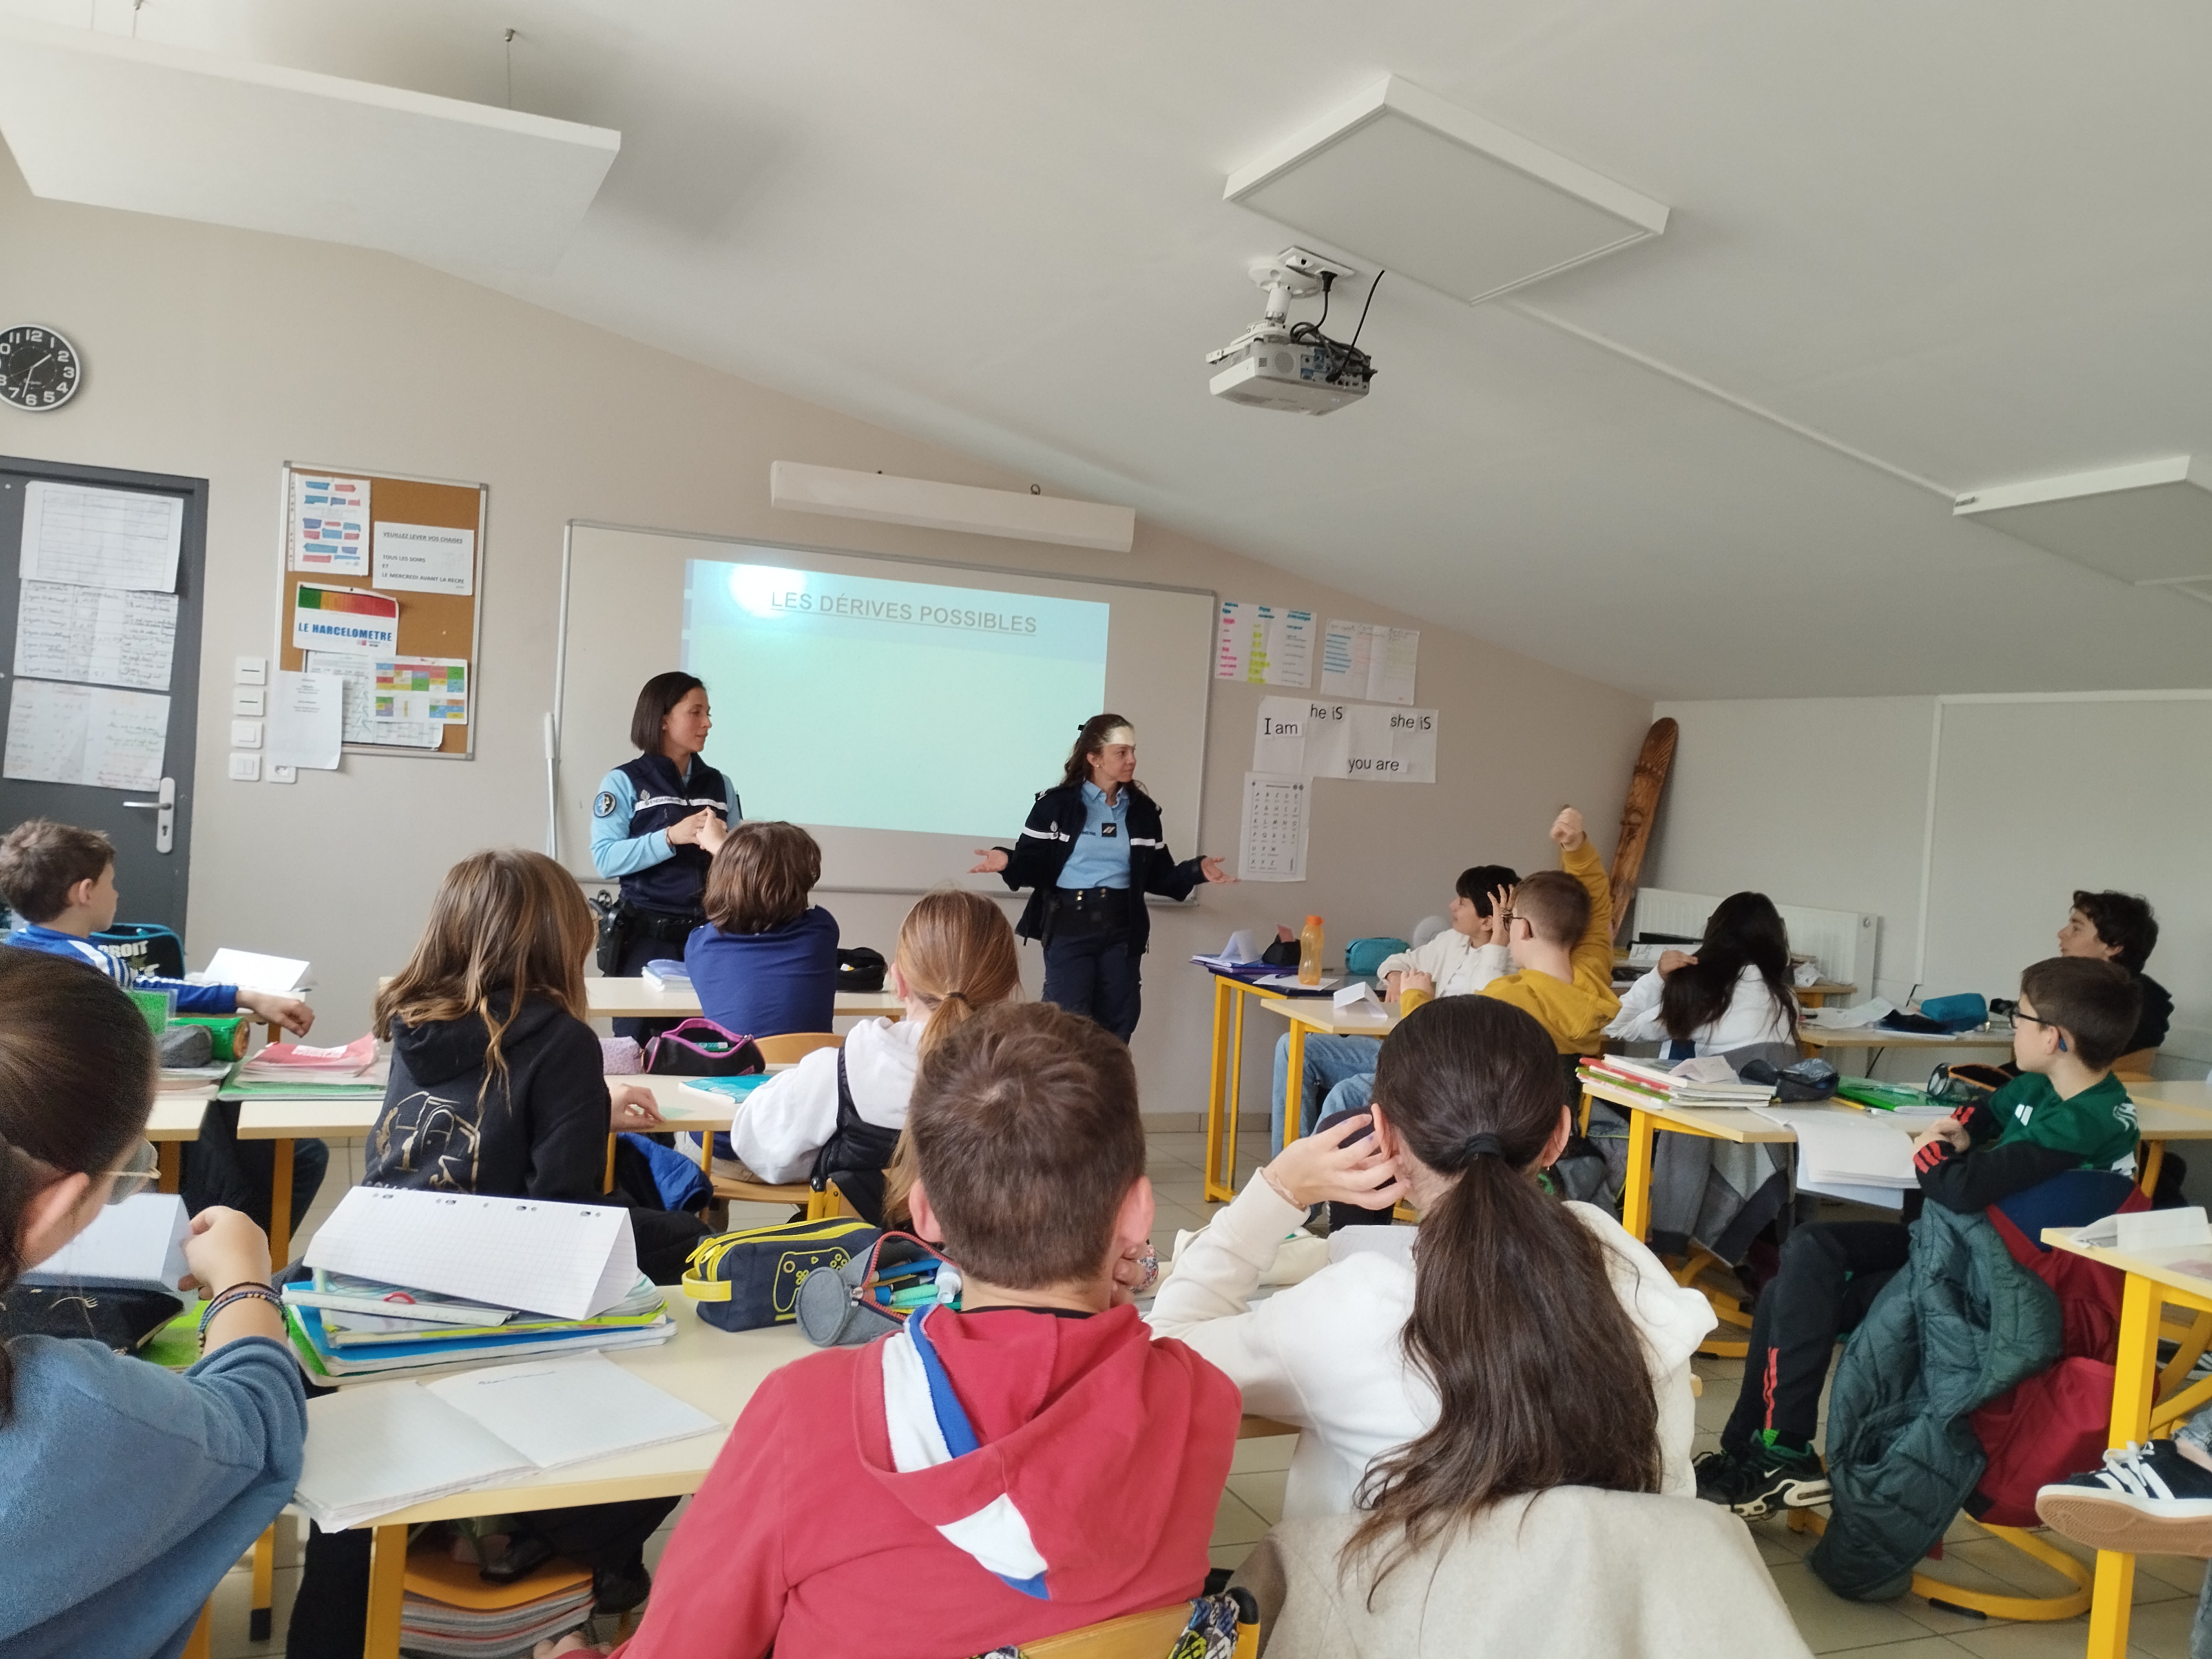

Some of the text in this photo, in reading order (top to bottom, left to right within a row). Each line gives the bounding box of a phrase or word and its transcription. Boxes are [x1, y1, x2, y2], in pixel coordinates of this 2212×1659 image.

[9, 332, 20, 343] 11
[26, 329, 43, 342] 12
[50, 337, 55, 348] 1
[58, 351, 69, 362] 2
[63, 367, 75, 378] 3
[8, 387, 19, 398] 7
[56, 382, 69, 393] 4
[25, 394, 37, 405] 6
[44, 391, 55, 403] 5
[772, 591, 1037, 633] LES DÉRIVES POSSIBLES
[298, 622, 392, 641] LE HARCELOMETRE
[1310, 703, 1327, 719] he
[1264, 718, 1298, 735] I am
[1390, 714, 1415, 728] she
[1348, 758, 1399, 774] you are
